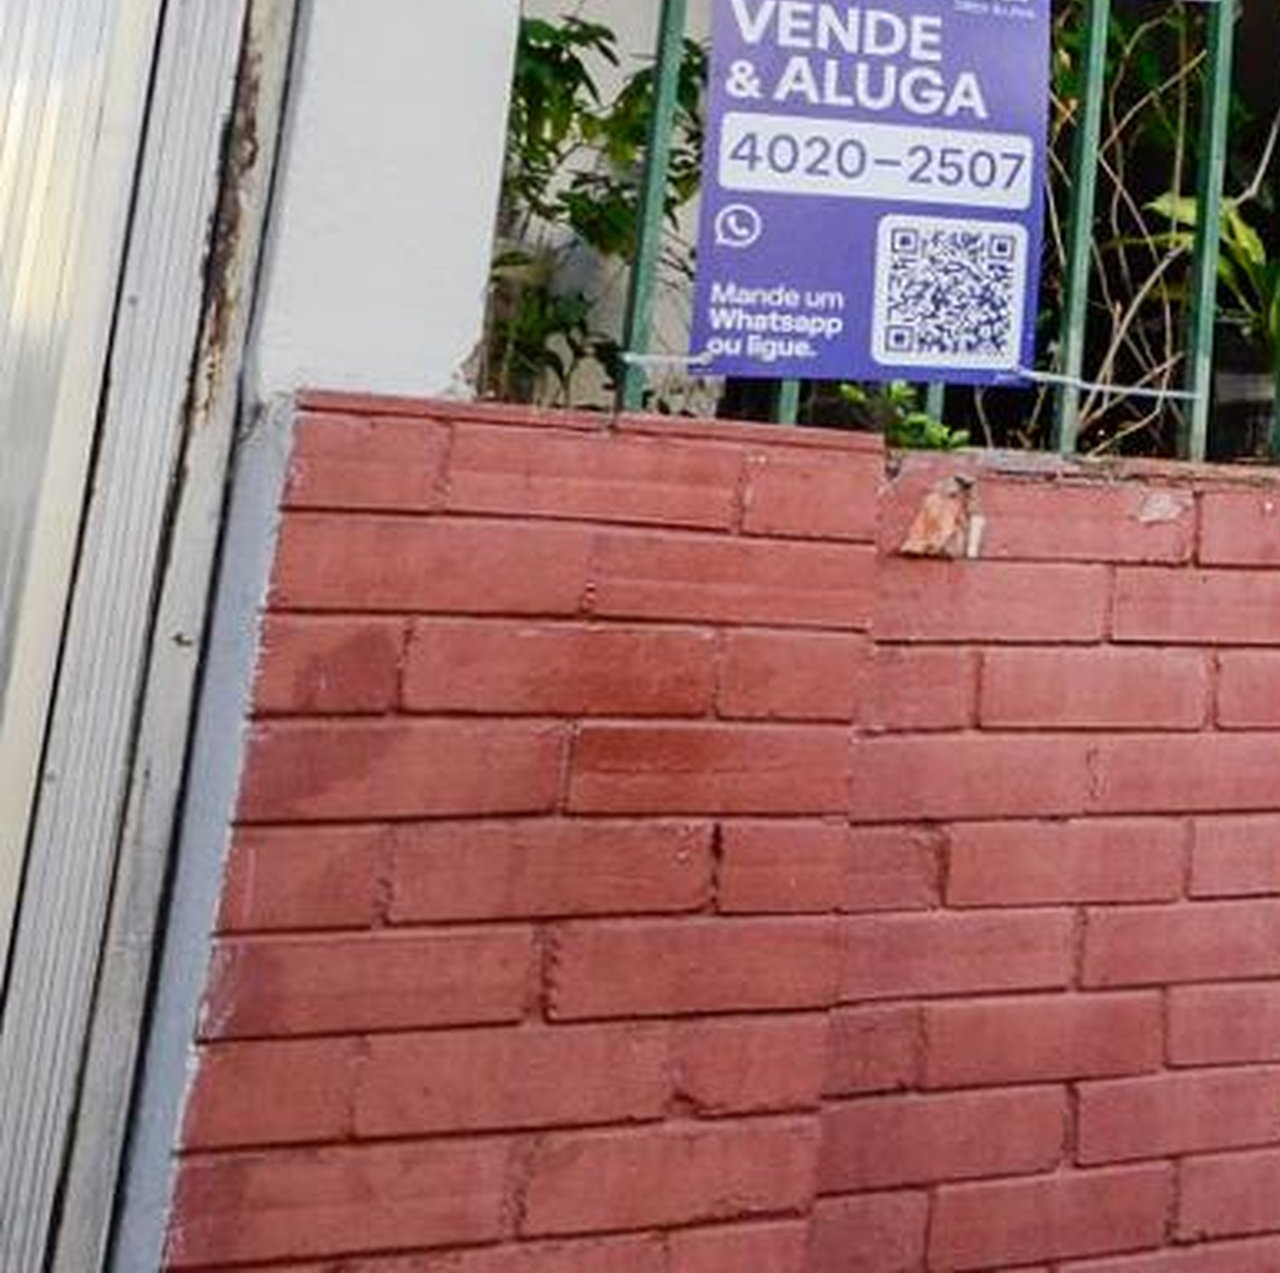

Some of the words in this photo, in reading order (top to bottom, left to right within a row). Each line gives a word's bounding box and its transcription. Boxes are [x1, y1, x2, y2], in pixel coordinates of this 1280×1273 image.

[724, 59, 763, 99] &
[772, 55, 989, 120] ALUGA
[728, 131, 1027, 190] 4020-2507
[710, 282, 799, 307] Mande
[805, 288, 844, 308] um
[709, 307, 843, 340] Whatsapp
[706, 336, 742, 357] ou
[746, 333, 819, 362] ligue.
